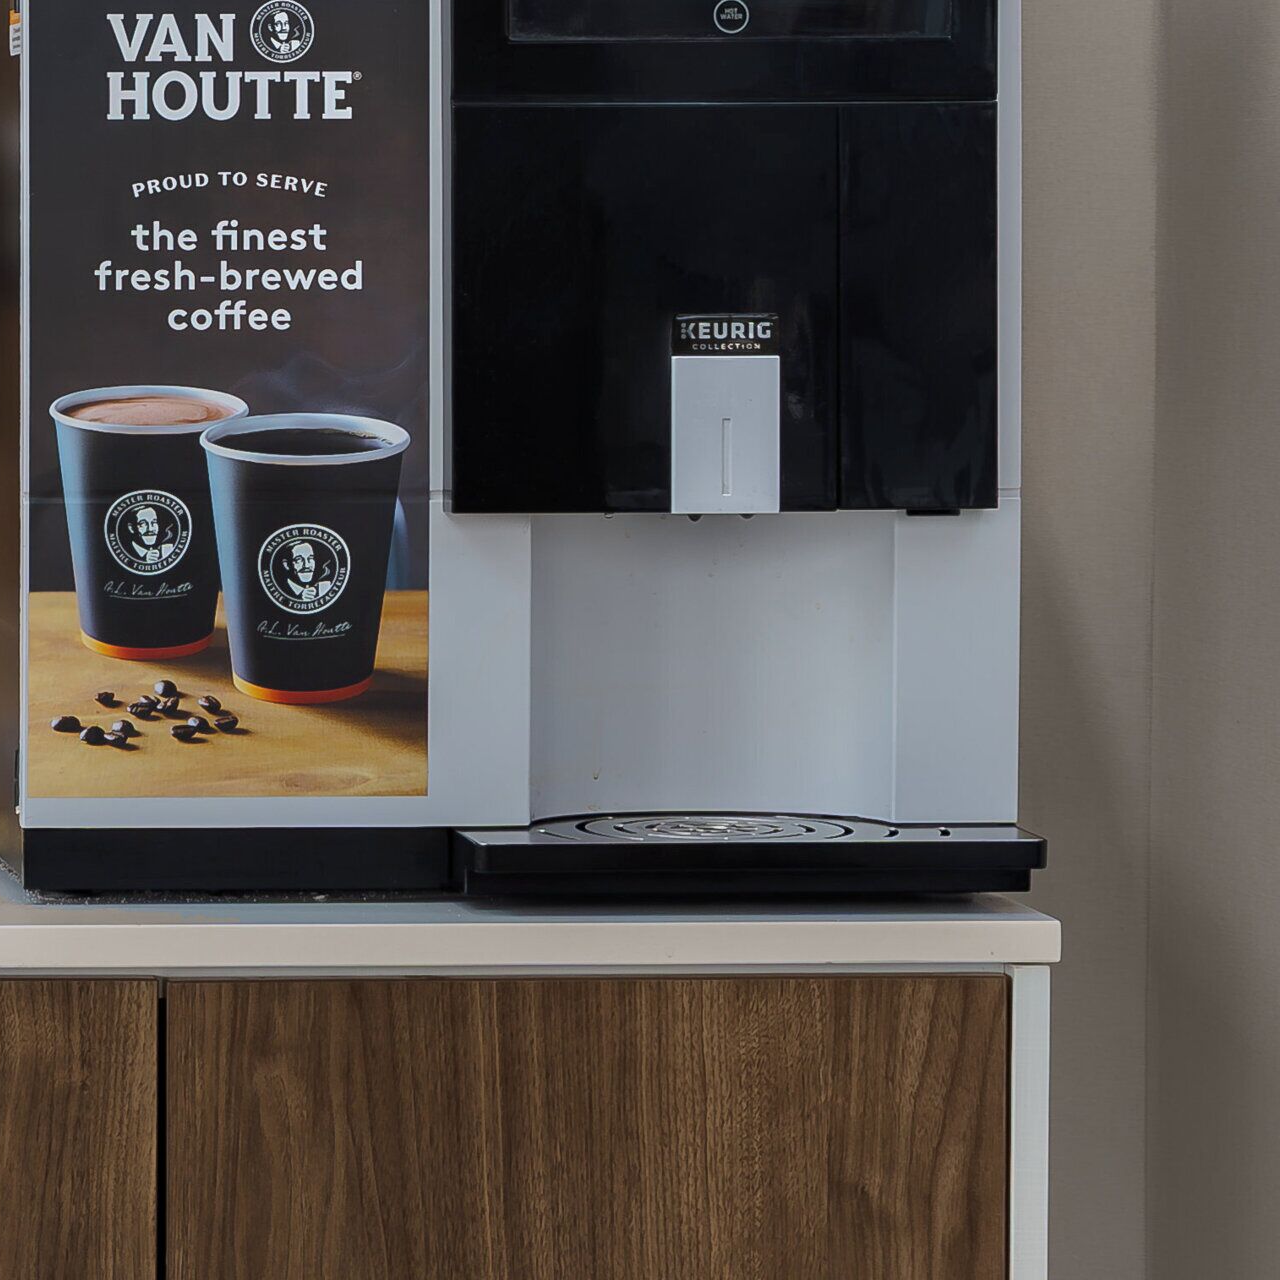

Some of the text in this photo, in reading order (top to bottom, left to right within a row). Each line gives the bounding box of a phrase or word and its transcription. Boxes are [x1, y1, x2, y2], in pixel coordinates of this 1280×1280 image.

[107, 14, 235, 62] VAN
[107, 70, 352, 120] HOUTTE
[131, 171, 328, 198] PROUD TO SERVE
[131, 220, 326, 251] the finest
[95, 260, 362, 291] fresh-brewed
[168, 300, 291, 330] coffee
[681, 322, 772, 339] KEURIG
[112, 495, 184, 517] MASTER ROASTER
[266, 529, 342, 553] MASTER ROASTER
